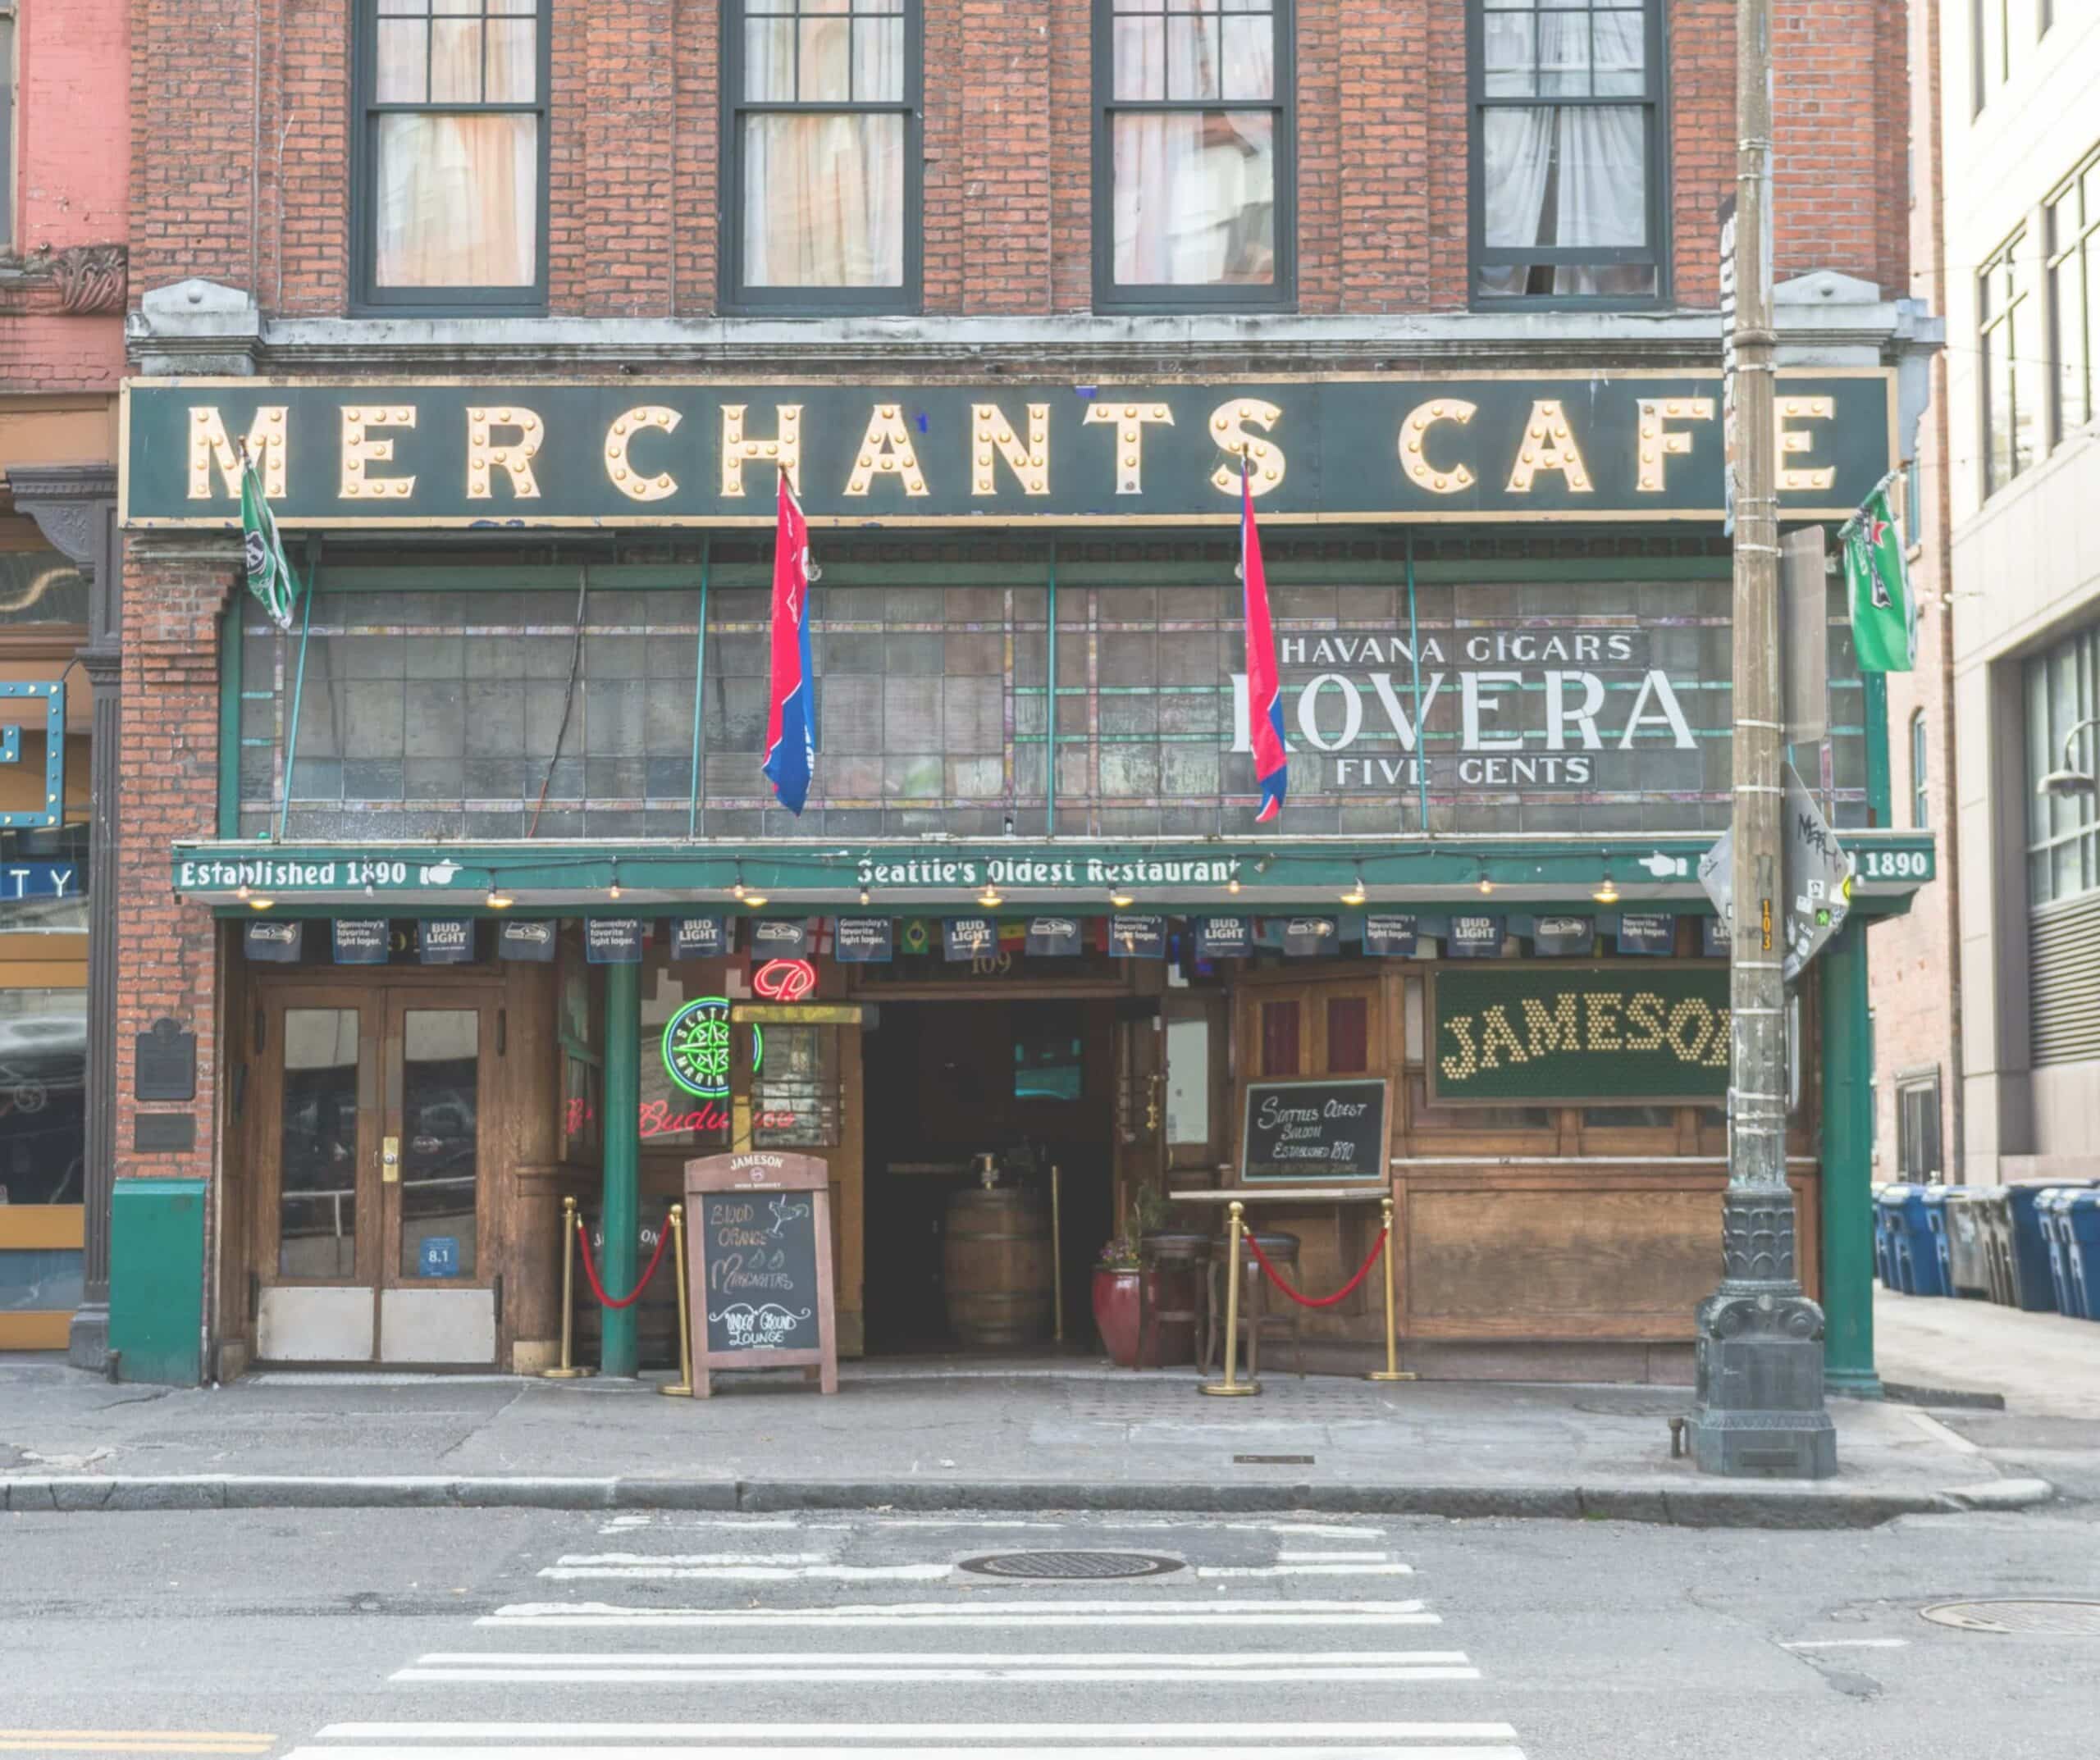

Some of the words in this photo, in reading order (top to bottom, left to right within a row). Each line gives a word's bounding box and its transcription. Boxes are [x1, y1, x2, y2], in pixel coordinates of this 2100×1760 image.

[187, 398, 1286, 501] MERCHANTS
[1399, 395, 1836, 492] CAFE
[1282, 637, 1445, 663] HAVANA
[1337, 759, 1431, 785] FIVE
[1865, 852, 1927, 876] 1890
[180, 861, 334, 886] Established
[347, 862, 406, 885] 1890
[857, 859, 976, 883] Seattle's
[988, 859, 1075, 883] Oldest
[1088, 859, 1239, 882] Restaurant
[431, 922, 459, 932] BUD
[683, 919, 712, 930] BUD
[956, 920, 985, 931] BUD
[1210, 919, 1239, 928] BUD
[1461, 917, 1490, 927] BUD
[1762, 899, 1772, 950] 103
[427, 932, 466, 944] LIGHT
[679, 929, 717, 941] LIGHT
[952, 930, 991, 942] LIGHT
[1205, 928, 1244, 939] LIGHT
[1455, 928, 1495, 938] LIGHT
[730, 1155, 784, 1170] JAMESON
[428, 1250, 449, 1263] 8.1
